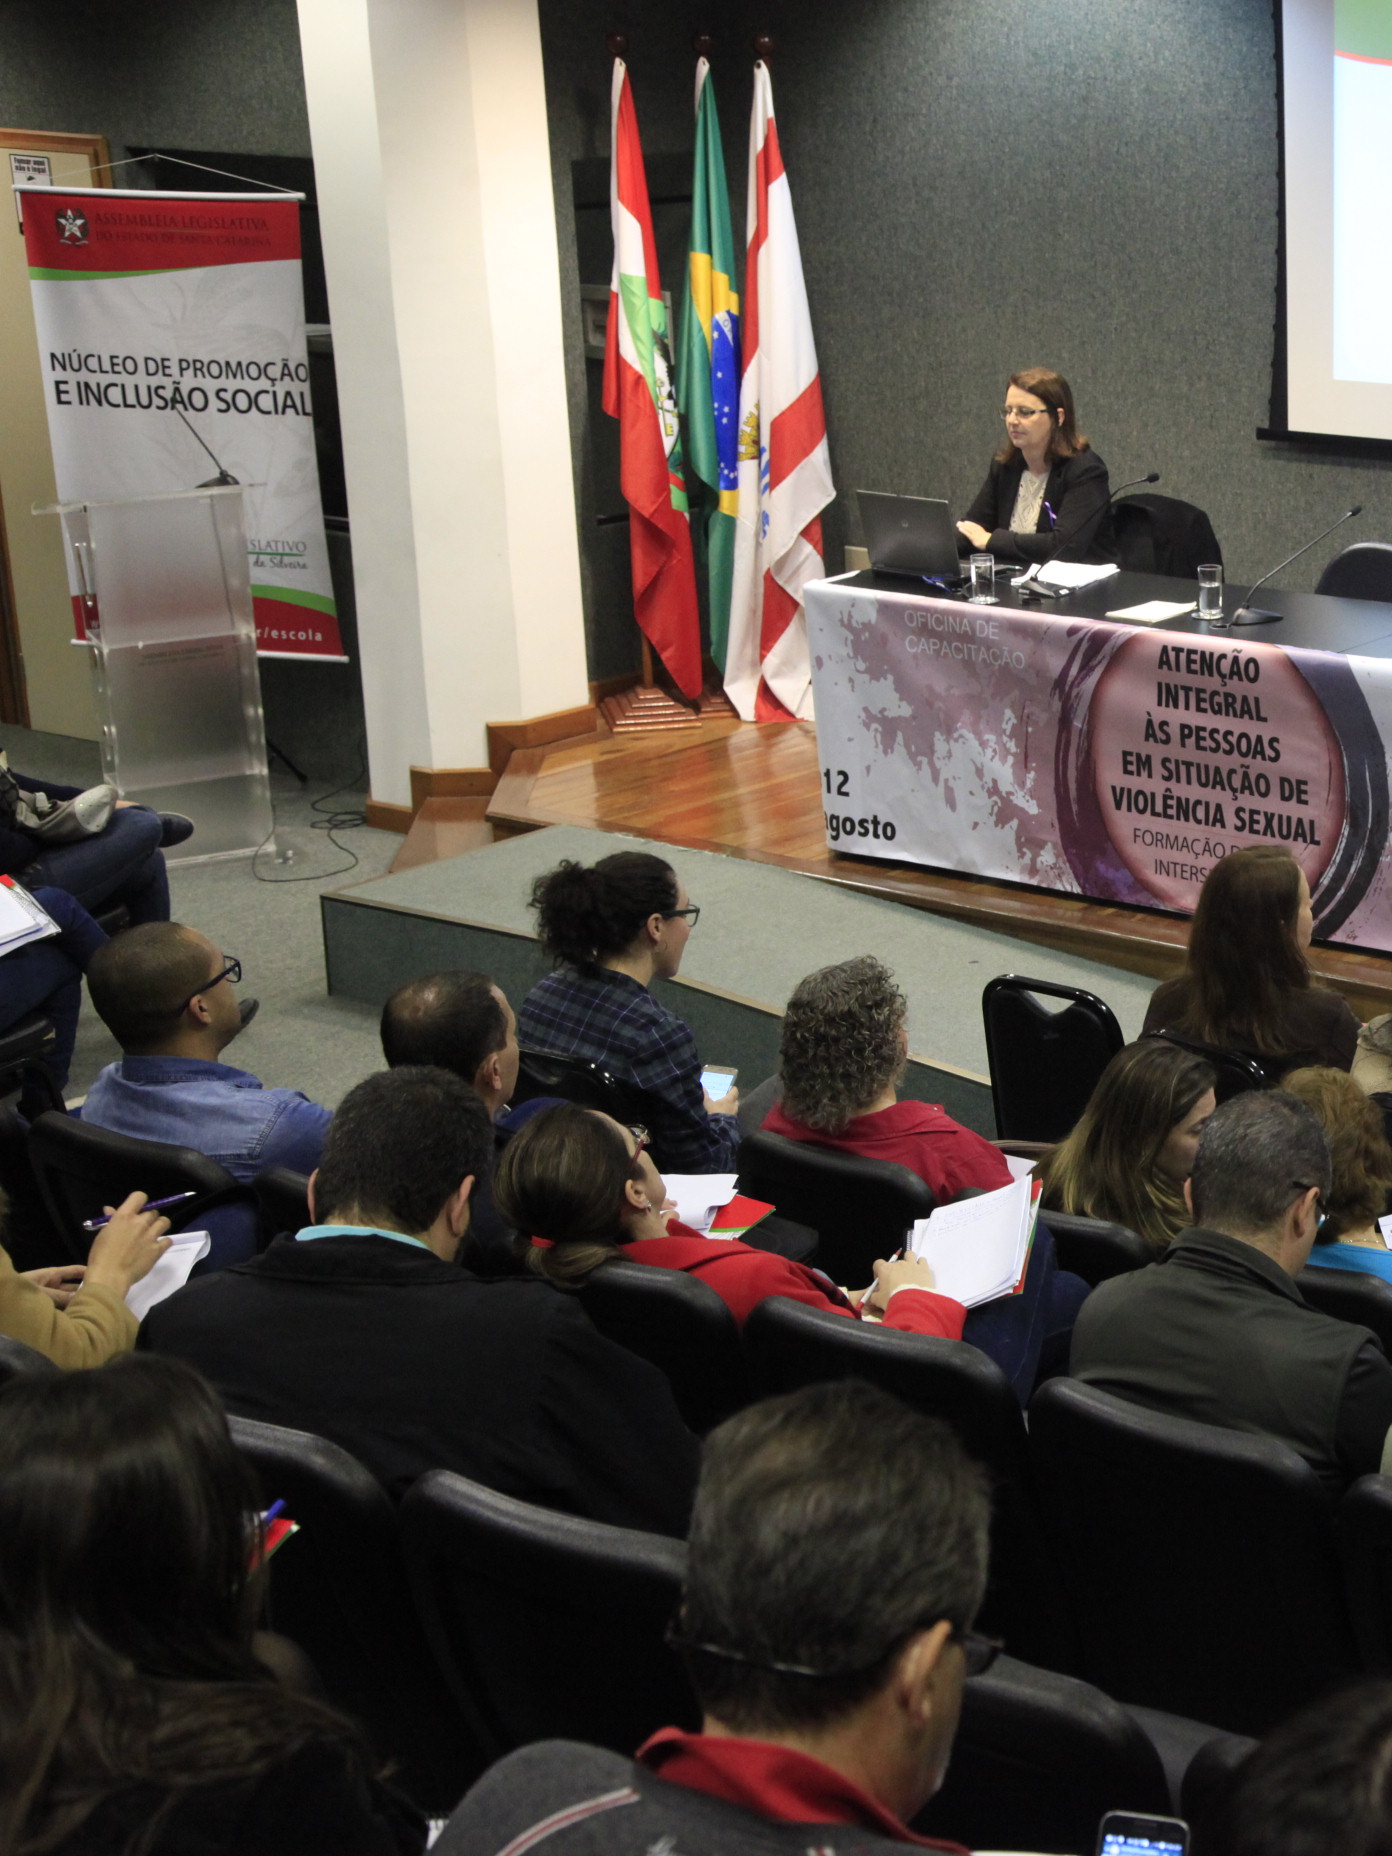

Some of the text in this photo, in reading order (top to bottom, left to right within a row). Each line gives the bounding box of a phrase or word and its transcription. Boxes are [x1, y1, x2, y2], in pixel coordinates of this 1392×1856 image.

[95, 213, 269, 231] ASSEMBLEIA LEGISLATIVA
[50, 349, 309, 387] NÚCLEO DE PROMOÇÃO
[54, 380, 313, 417] E INCLUSÃO SOCIAL
[249, 539, 307, 553] SLATIVO
[904, 609, 1000, 640] OFICINA DE
[905, 635, 1025, 669] CAPACITAÇÃO
[1158, 644, 1260, 687] ATENÇÃO
[1157, 681, 1268, 723] INTEGRAL
[1144, 711, 1281, 763] ÀS PESSOAS
[823, 768, 850, 797] 12
[1121, 750, 1309, 806] EM SITUAÇÃO DE
[1110, 785, 1321, 846] VIOLÊNCIA SEXUAL
[1133, 827, 1226, 860] FORMAÇÃO
